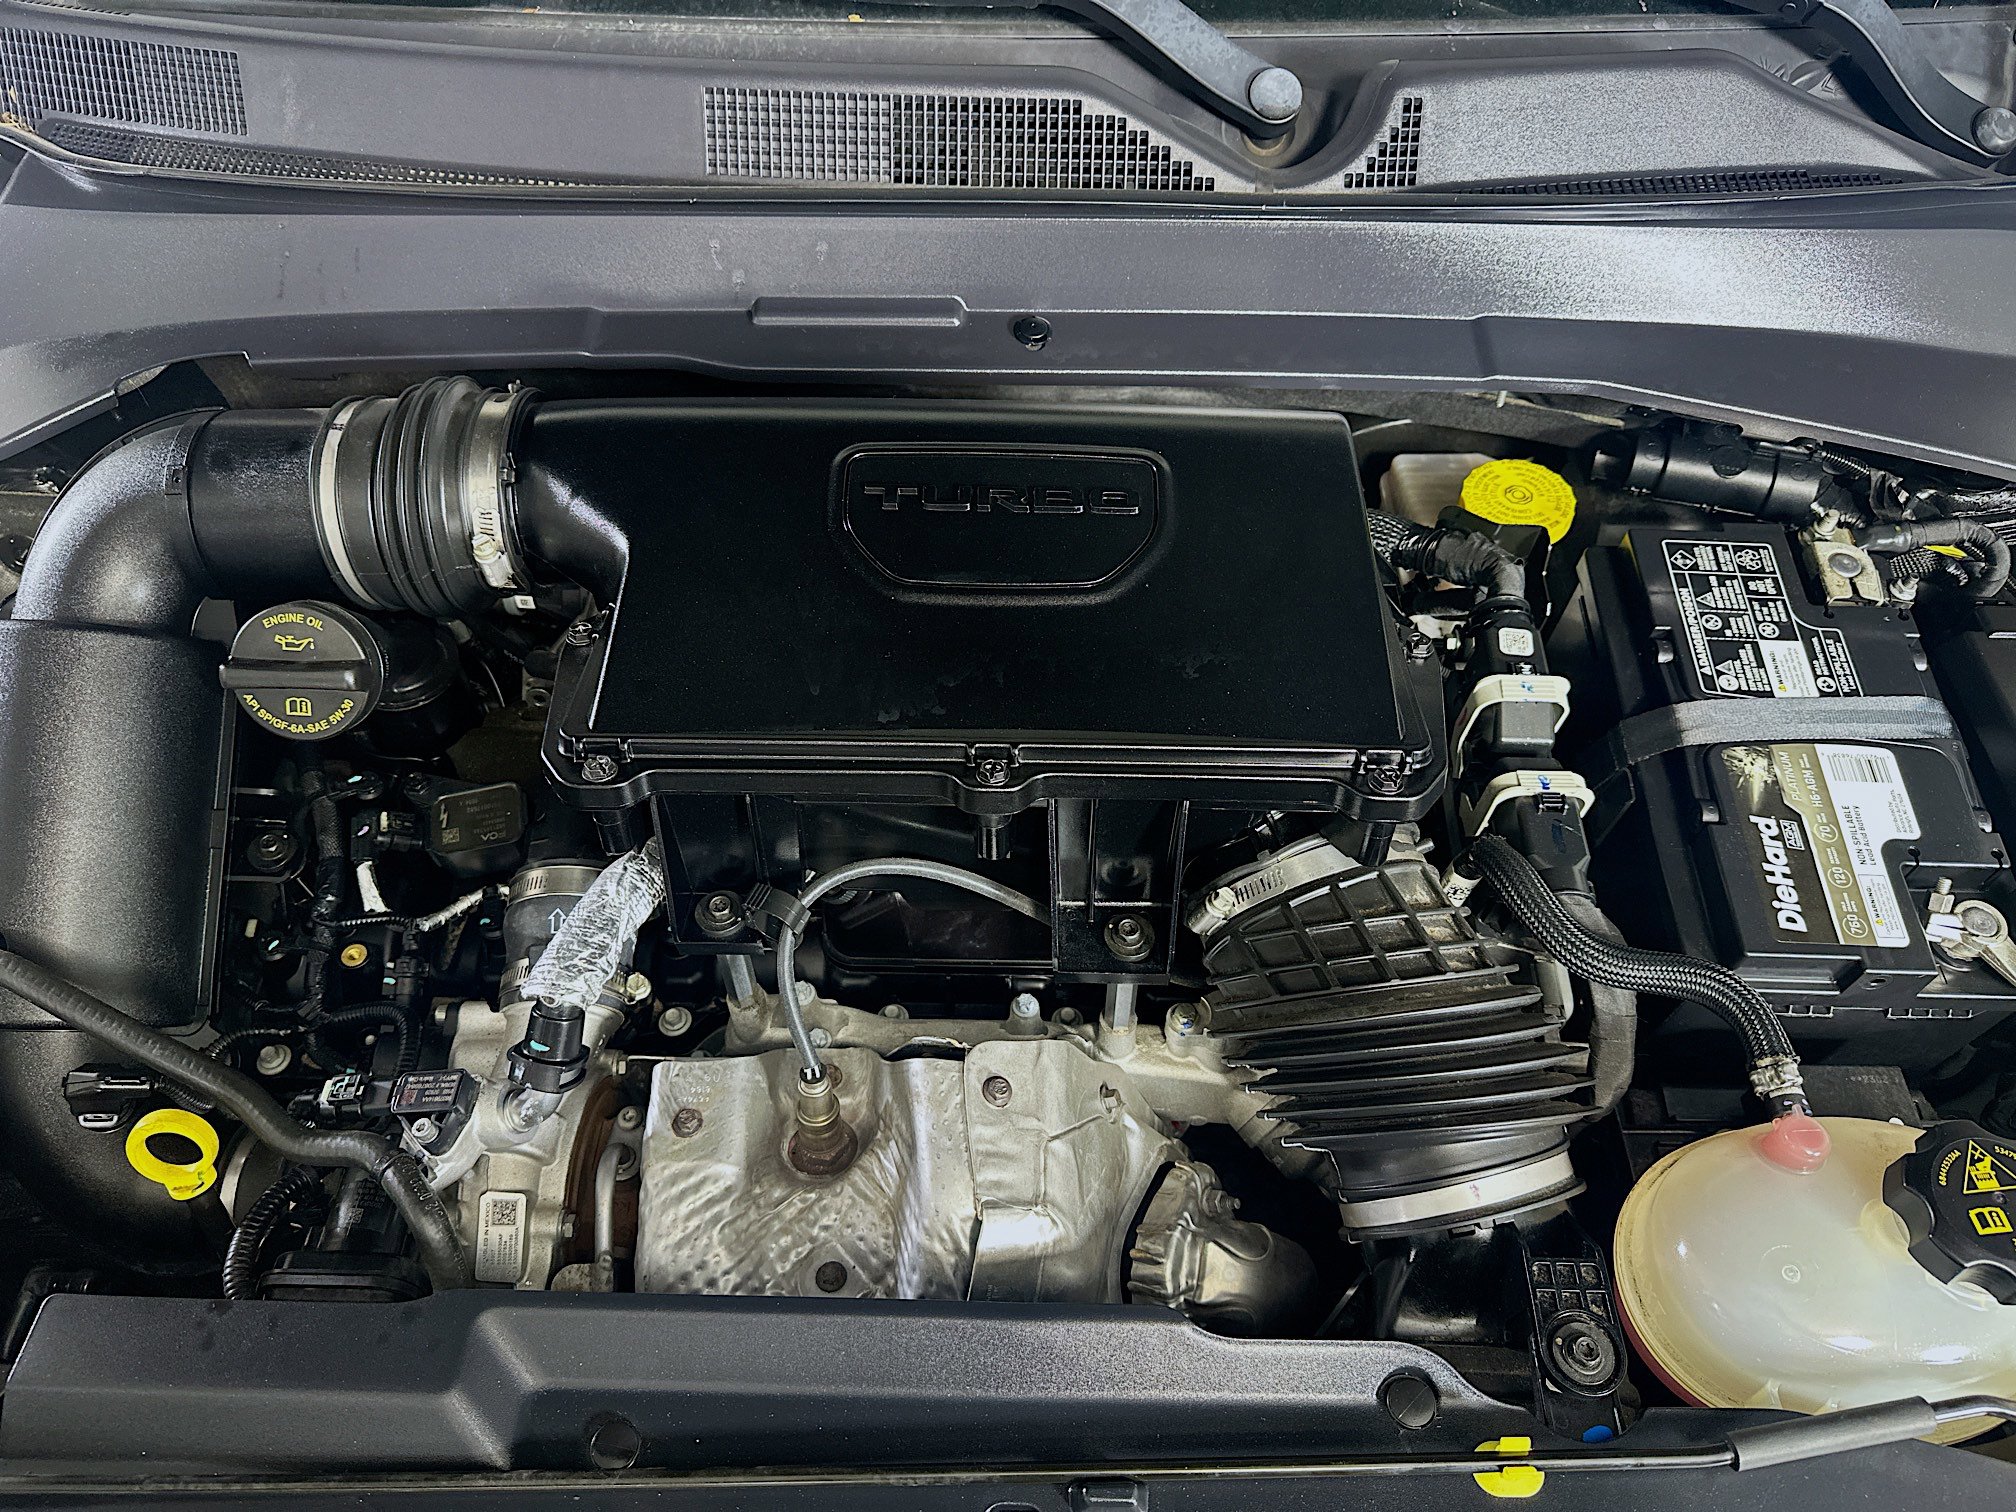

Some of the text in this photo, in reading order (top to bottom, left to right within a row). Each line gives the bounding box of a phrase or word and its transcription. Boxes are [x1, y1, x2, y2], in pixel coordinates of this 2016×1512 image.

[864, 485, 1140, 515] TURBO
[262, 613, 324, 631] ENGINE OIL
[1834, 642, 1847, 661] Battery
[1825, 638, 1850, 691] NON-SPILLABLE
[243, 693, 354, 734] API SP/GF-6A-SAE 5W-30
[1779, 751, 1802, 800] PLATINUM
[1851, 805, 1866, 830] Battery
[1782, 821, 1798, 846] AGM
[1817, 824, 1832, 838] 70
[1841, 804, 1867, 865] NON-SPILLABLE
[1859, 832, 1870, 847] Acid
[1865, 848, 1876, 865] Lead
[1749, 815, 1808, 932] DieHard
[1831, 866, 1847, 884] 120
[1845, 913, 1863, 934] 760
